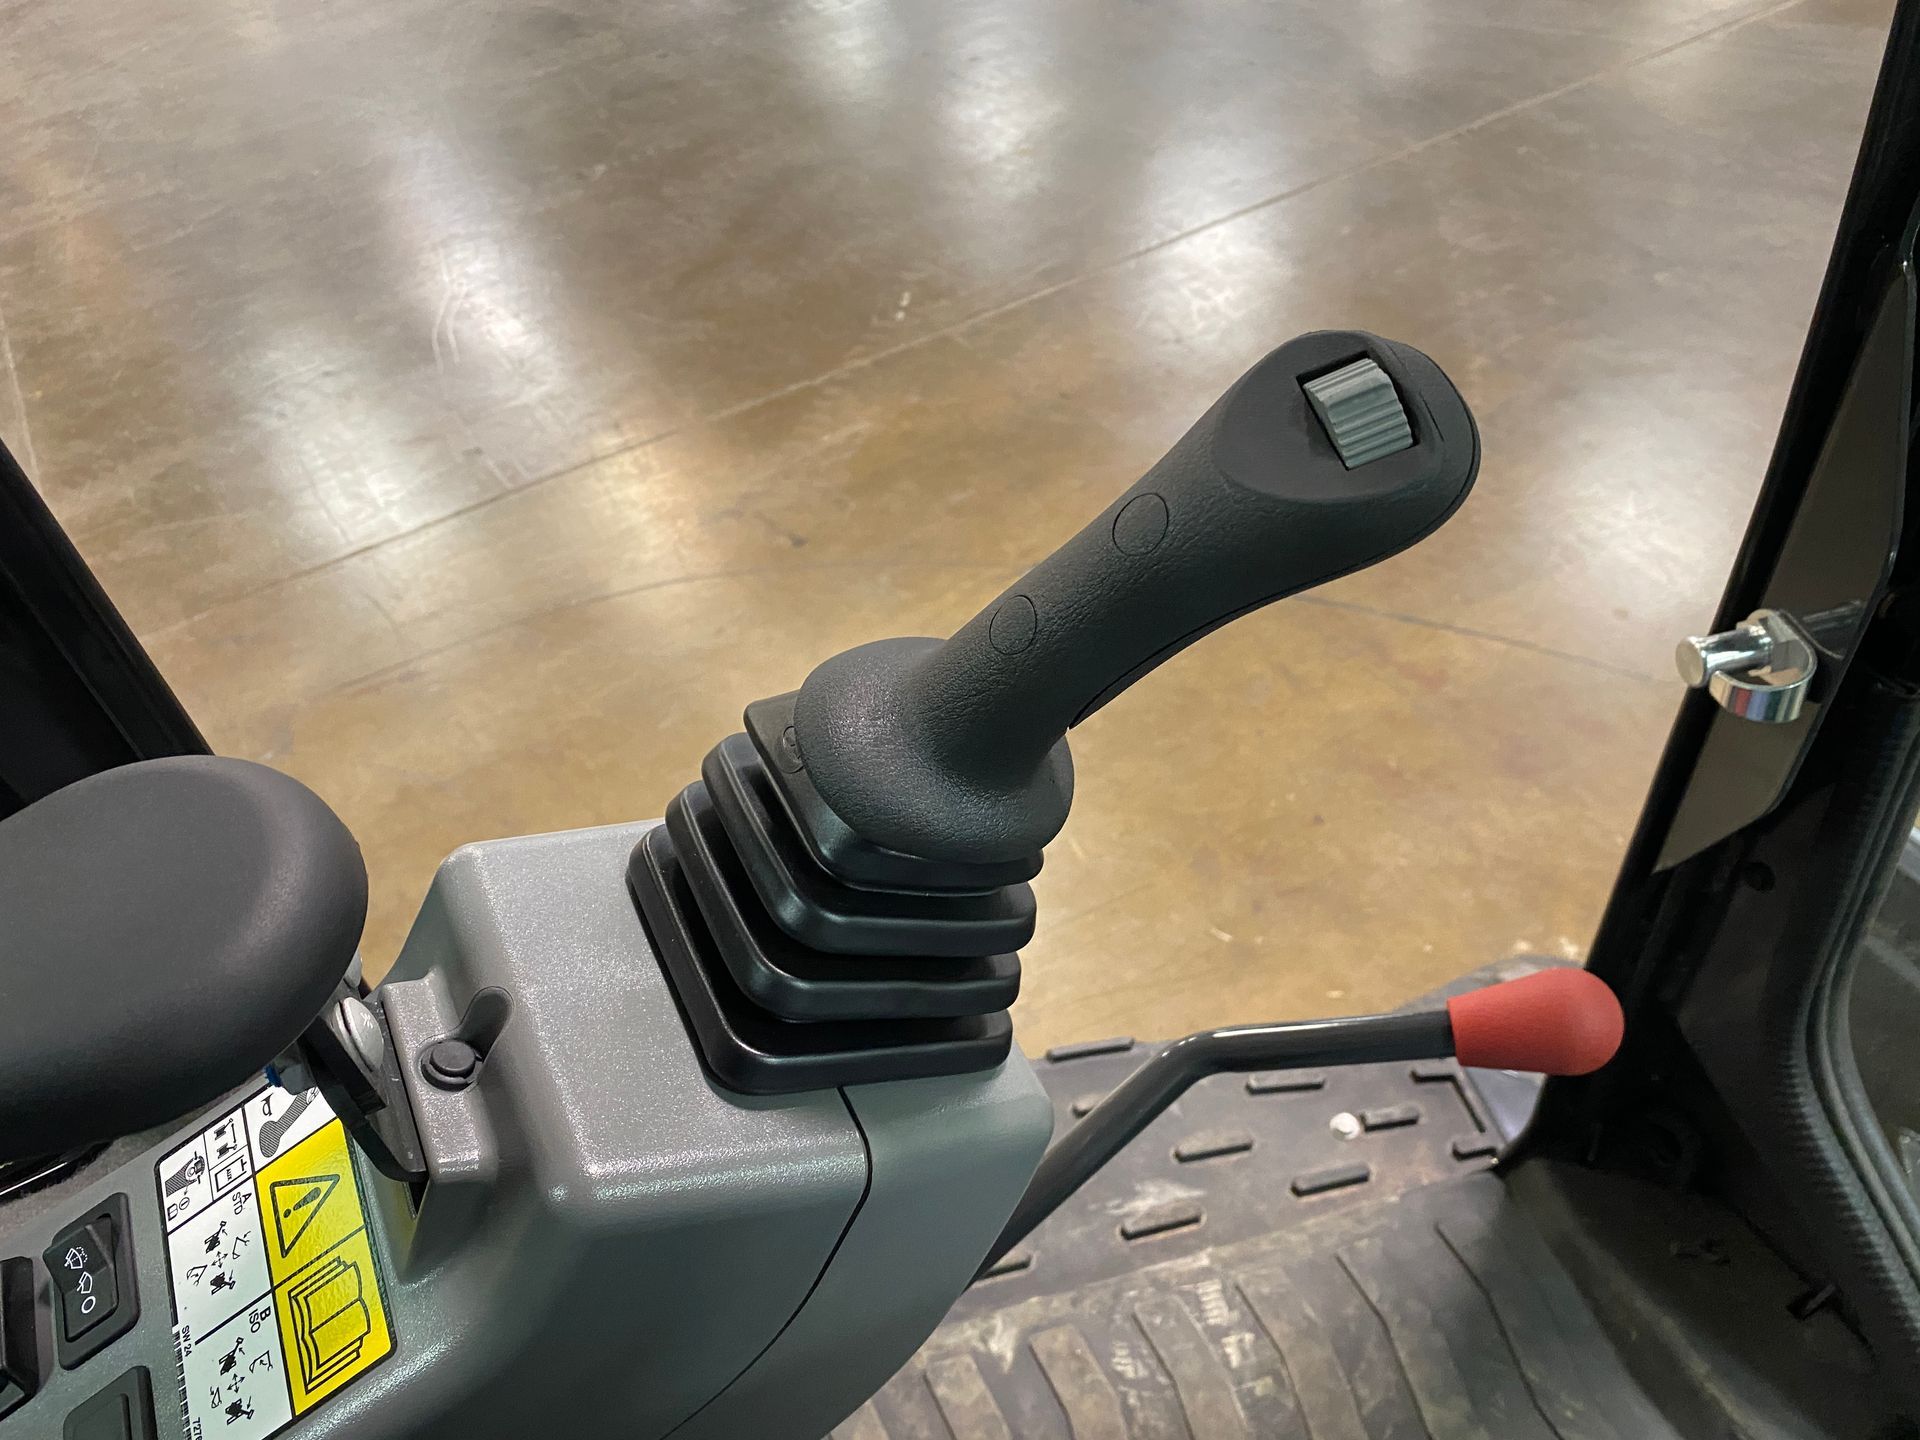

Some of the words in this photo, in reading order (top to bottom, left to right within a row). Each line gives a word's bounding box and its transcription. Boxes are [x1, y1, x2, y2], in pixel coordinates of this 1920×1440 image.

[232, 1192, 243, 1215] STD
[242, 1193, 252, 1204] A
[248, 1308, 261, 1333] ISO
[260, 1306, 271, 1321] B
[182, 1325, 191, 1342] SW
